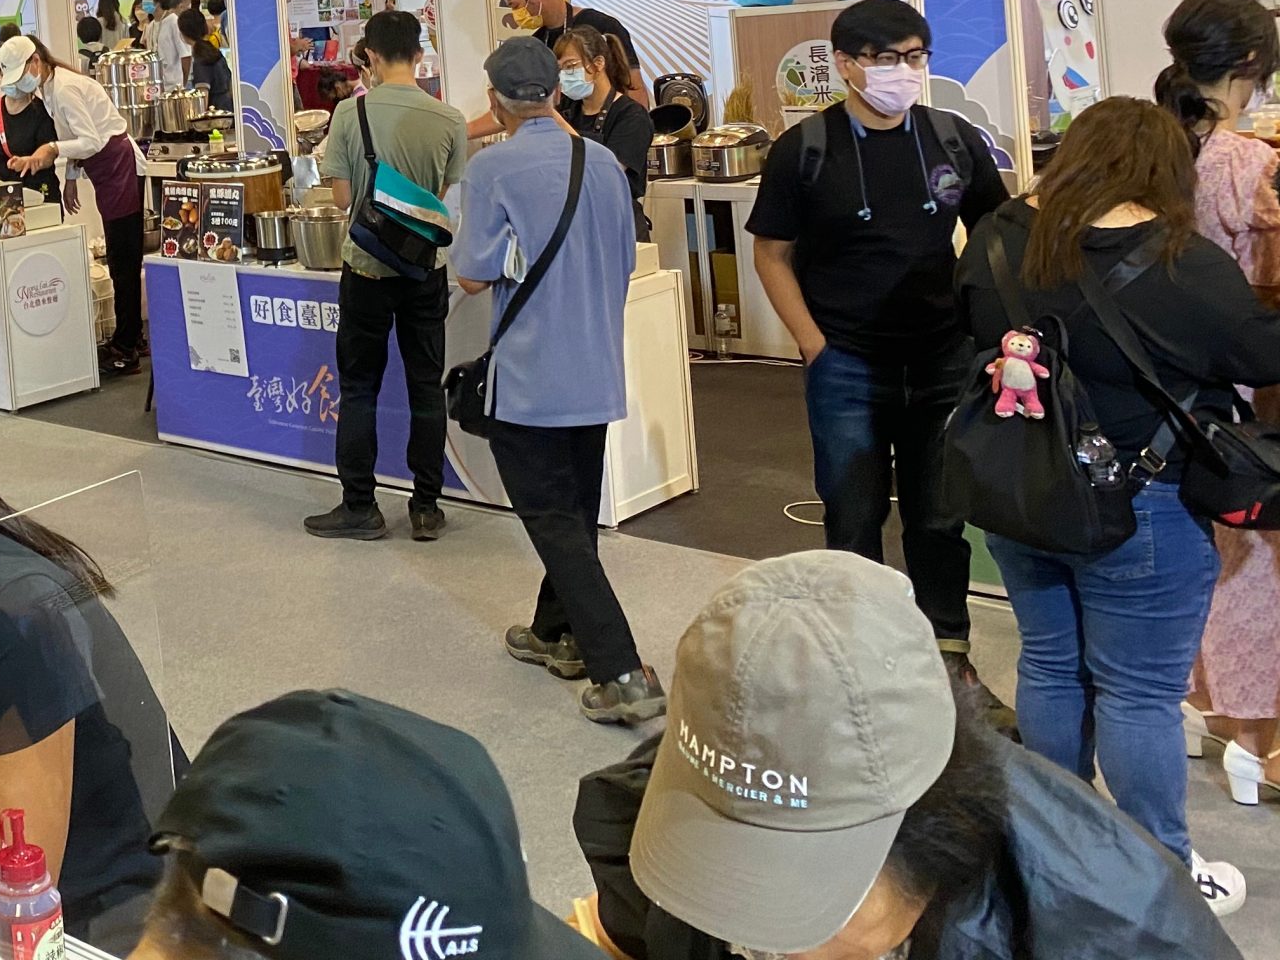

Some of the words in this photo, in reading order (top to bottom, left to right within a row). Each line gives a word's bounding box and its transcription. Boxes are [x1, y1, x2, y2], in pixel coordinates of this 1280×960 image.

[808, 45, 832, 104] 長濱米
[254, 299, 340, 329] 好食臺菜
[247, 365, 341, 422] 臺灣好食
[680, 720, 808, 796] HAMPTON
[712, 773, 768, 802] MERCIER
[773, 794, 783, 805] &
[790, 797, 808, 808] ME
